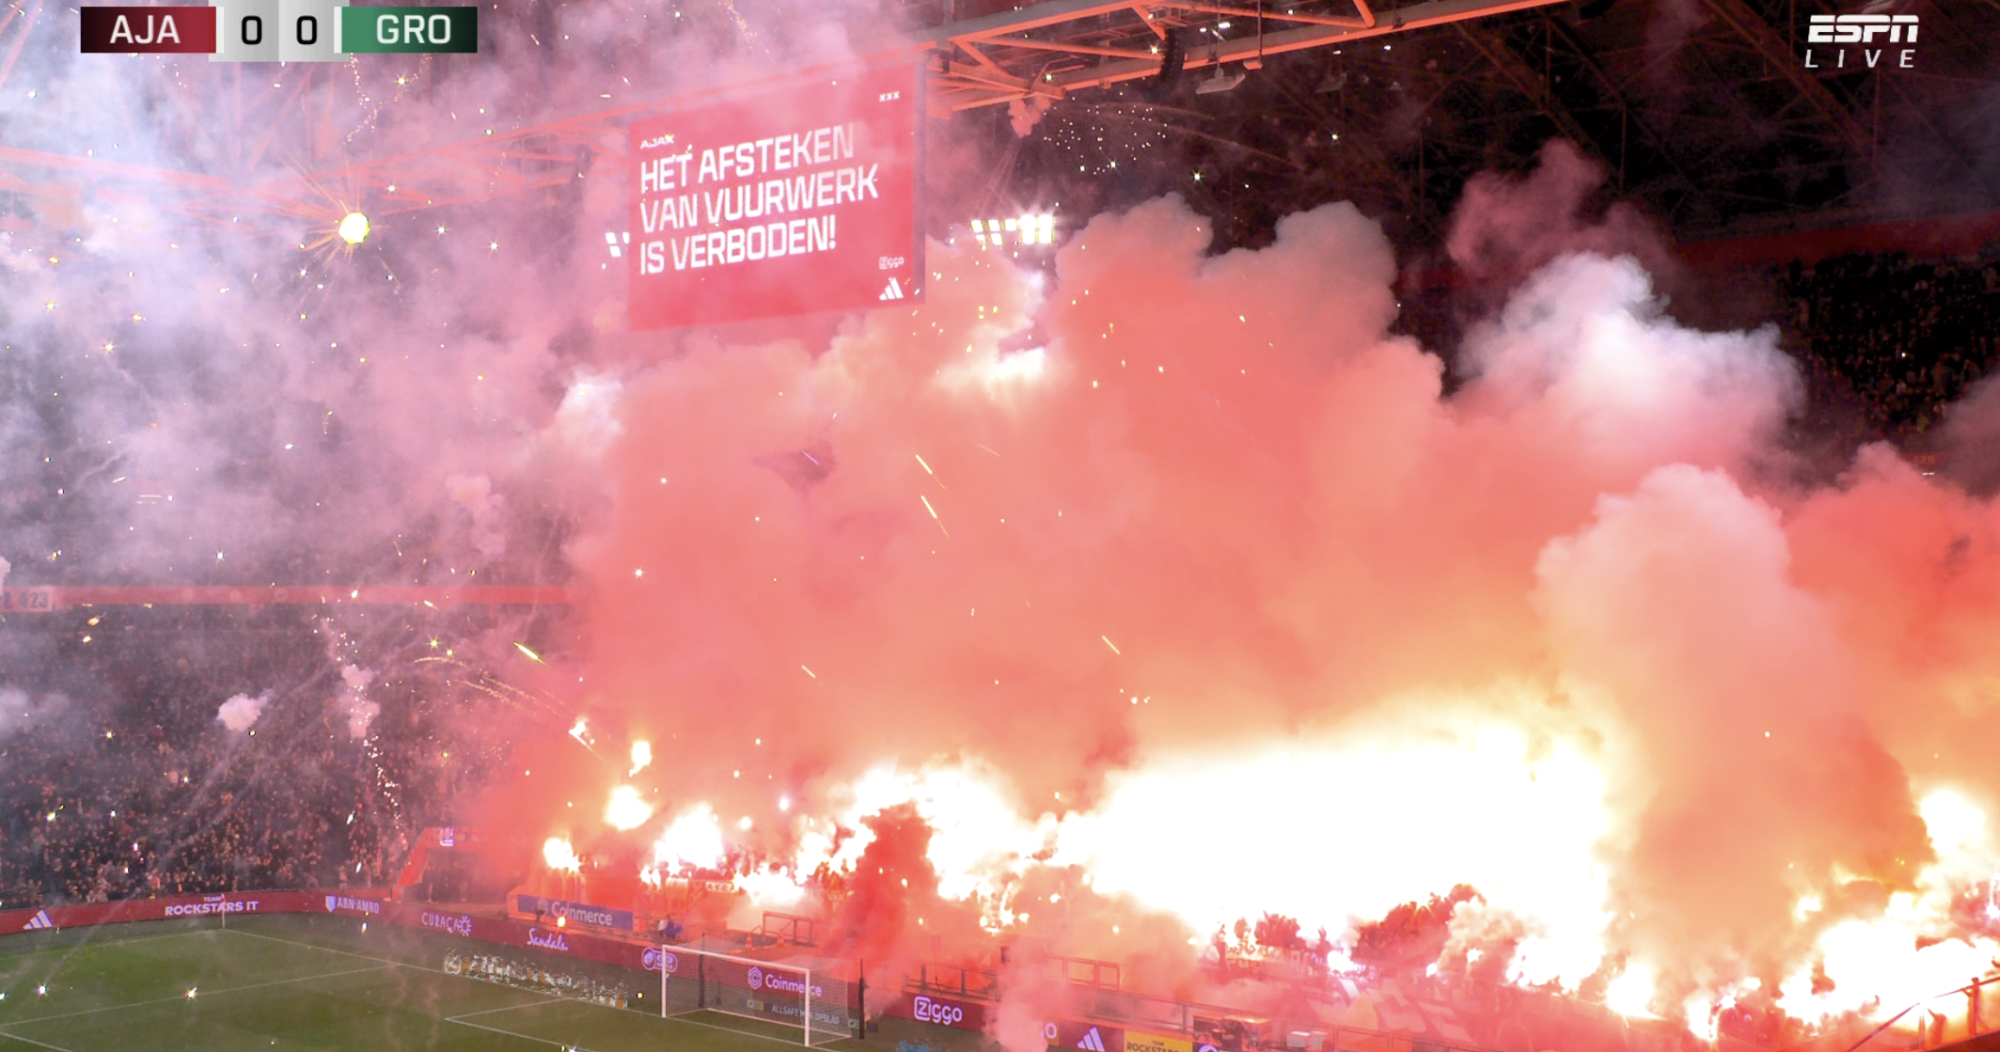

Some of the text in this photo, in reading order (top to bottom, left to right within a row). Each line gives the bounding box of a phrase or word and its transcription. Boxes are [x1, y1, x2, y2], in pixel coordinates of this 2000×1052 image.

[640, 133, 675, 149] AJAX
[640, 122, 855, 194] HET AFSTEKEN
[639, 163, 879, 233] VAN VUURWERK
[640, 214, 837, 275] IS VERBODEN!
[165, 901, 259, 916] ROCKSTARS IT
[551, 901, 613, 926] Coinmerce
[765, 973, 823, 997] Coinmece
